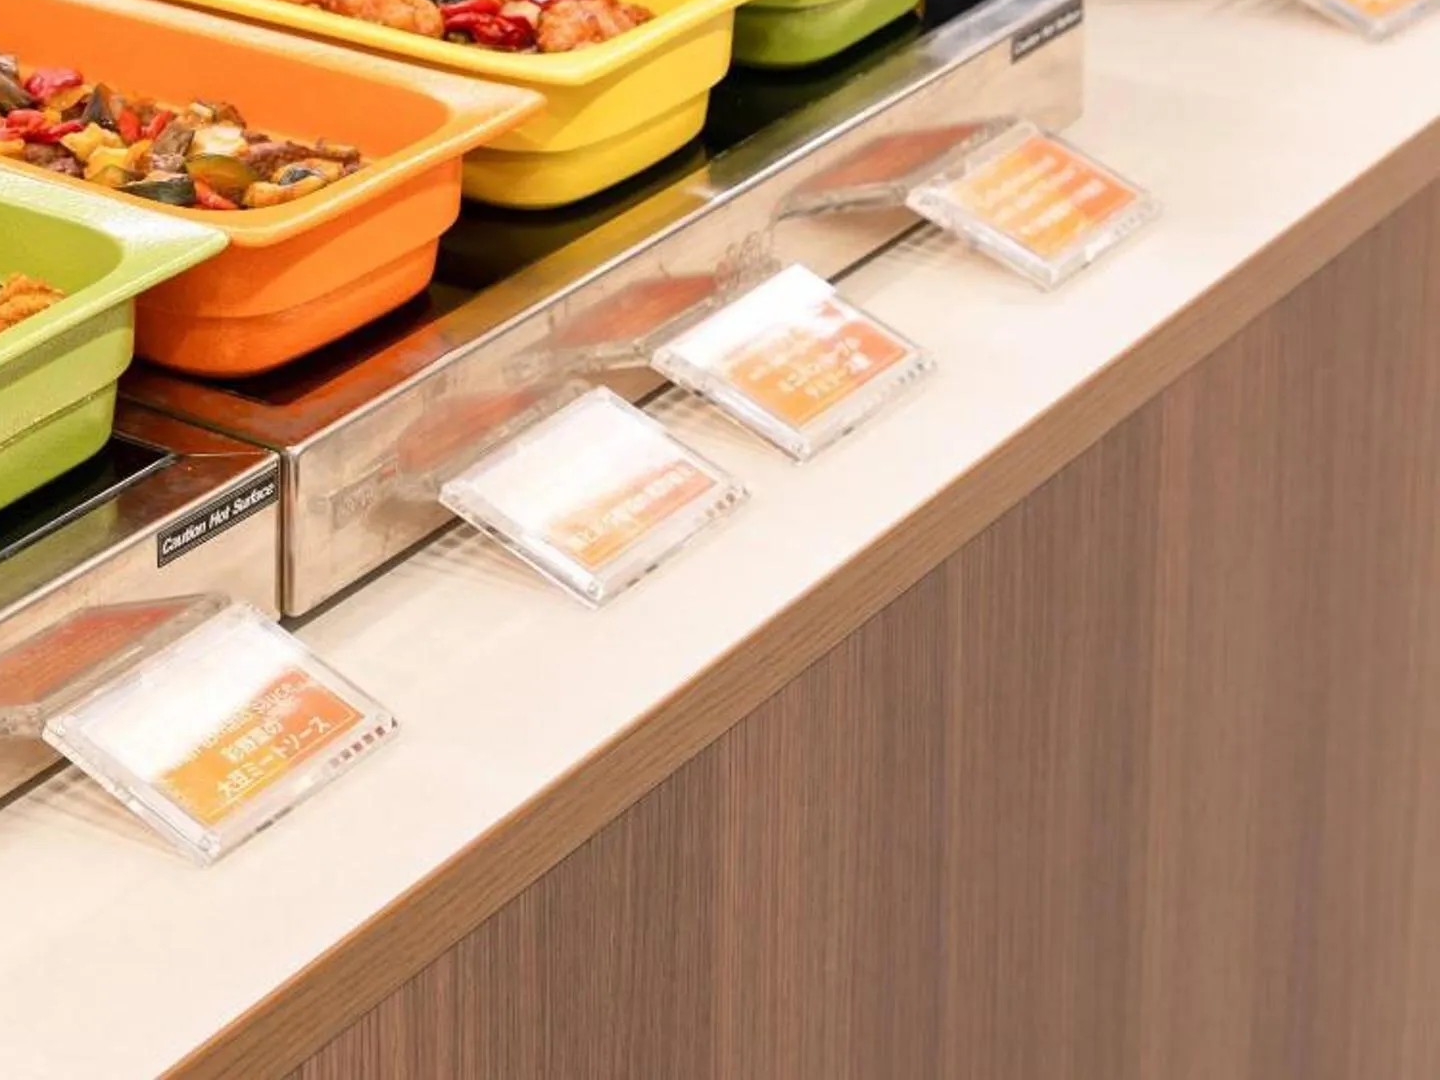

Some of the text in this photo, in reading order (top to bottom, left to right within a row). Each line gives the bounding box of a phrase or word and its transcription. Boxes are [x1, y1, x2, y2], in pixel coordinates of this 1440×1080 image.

[162, 482, 274, 554] Caution Hot Surface
